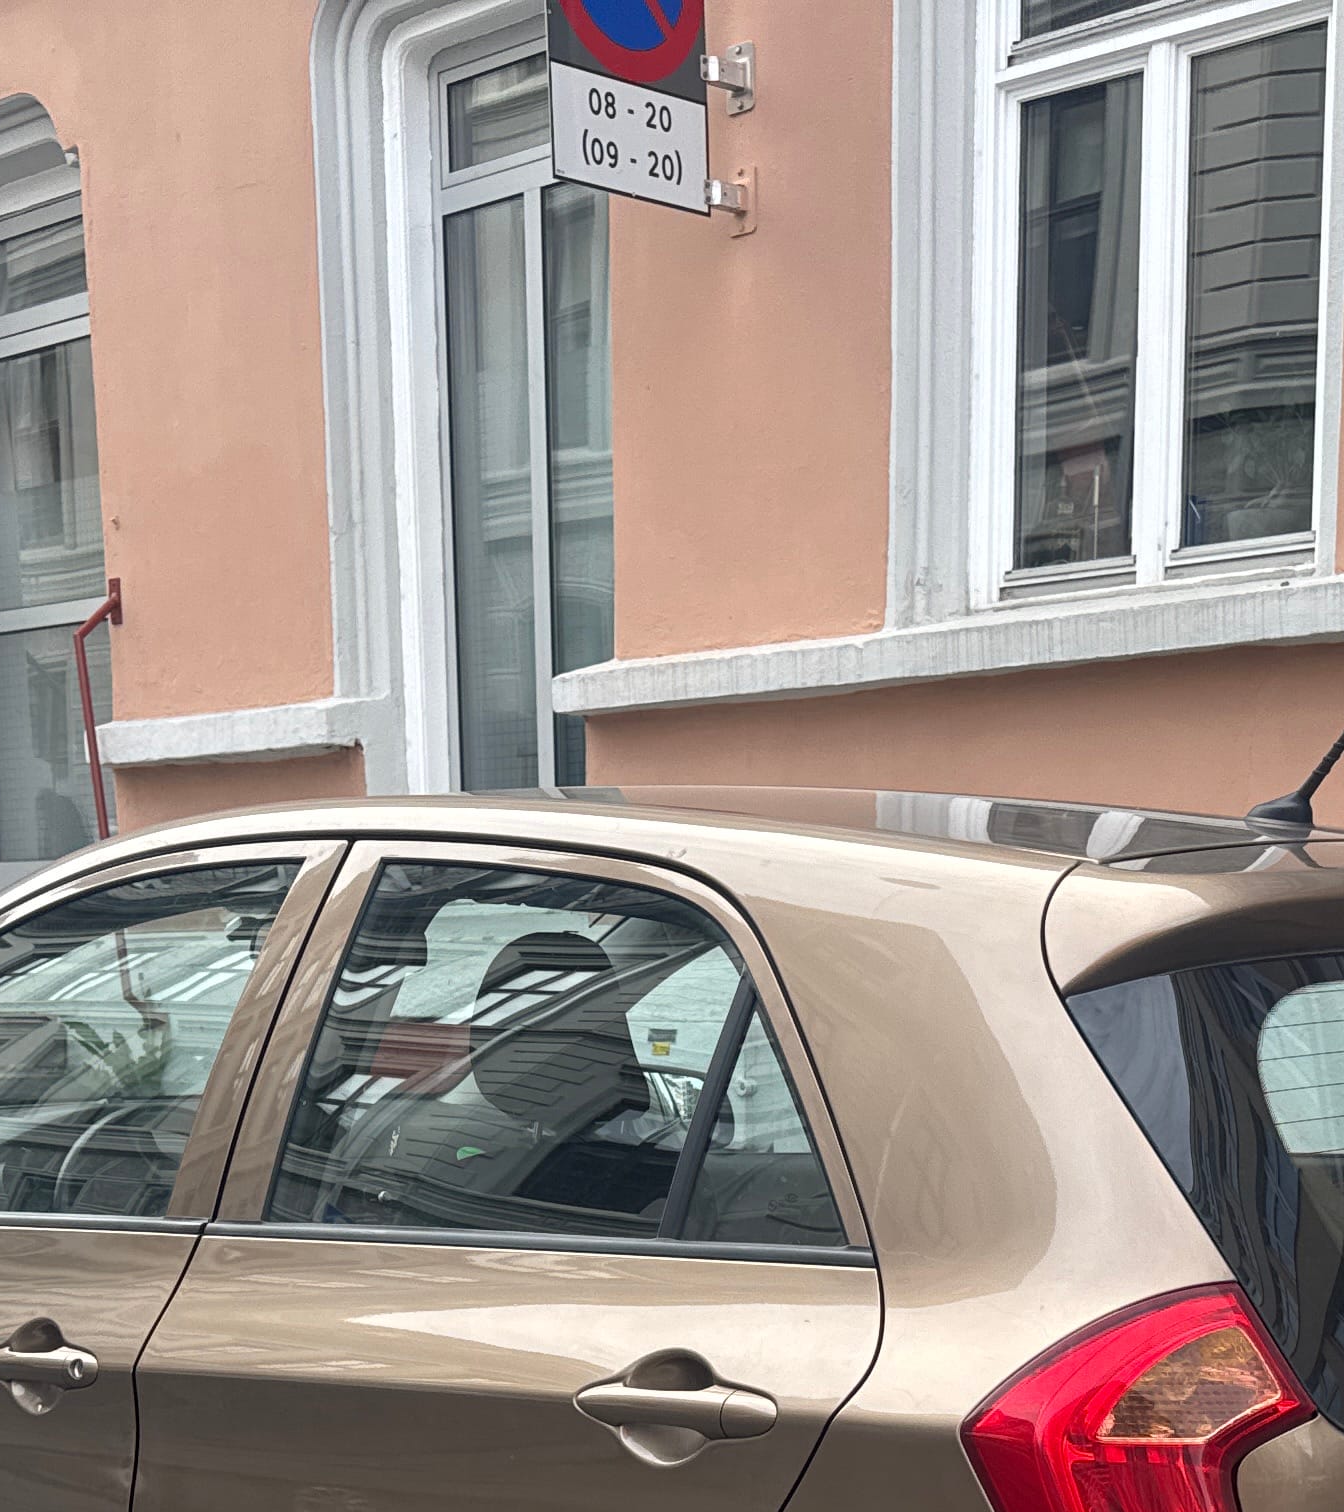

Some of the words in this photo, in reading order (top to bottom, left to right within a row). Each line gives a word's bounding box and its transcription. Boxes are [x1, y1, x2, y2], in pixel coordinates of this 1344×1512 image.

[588, 87, 616, 119] 08
[645, 102, 672, 132] 20
[582, 128, 619, 169] (09
[647, 150, 682, 185] 20)
